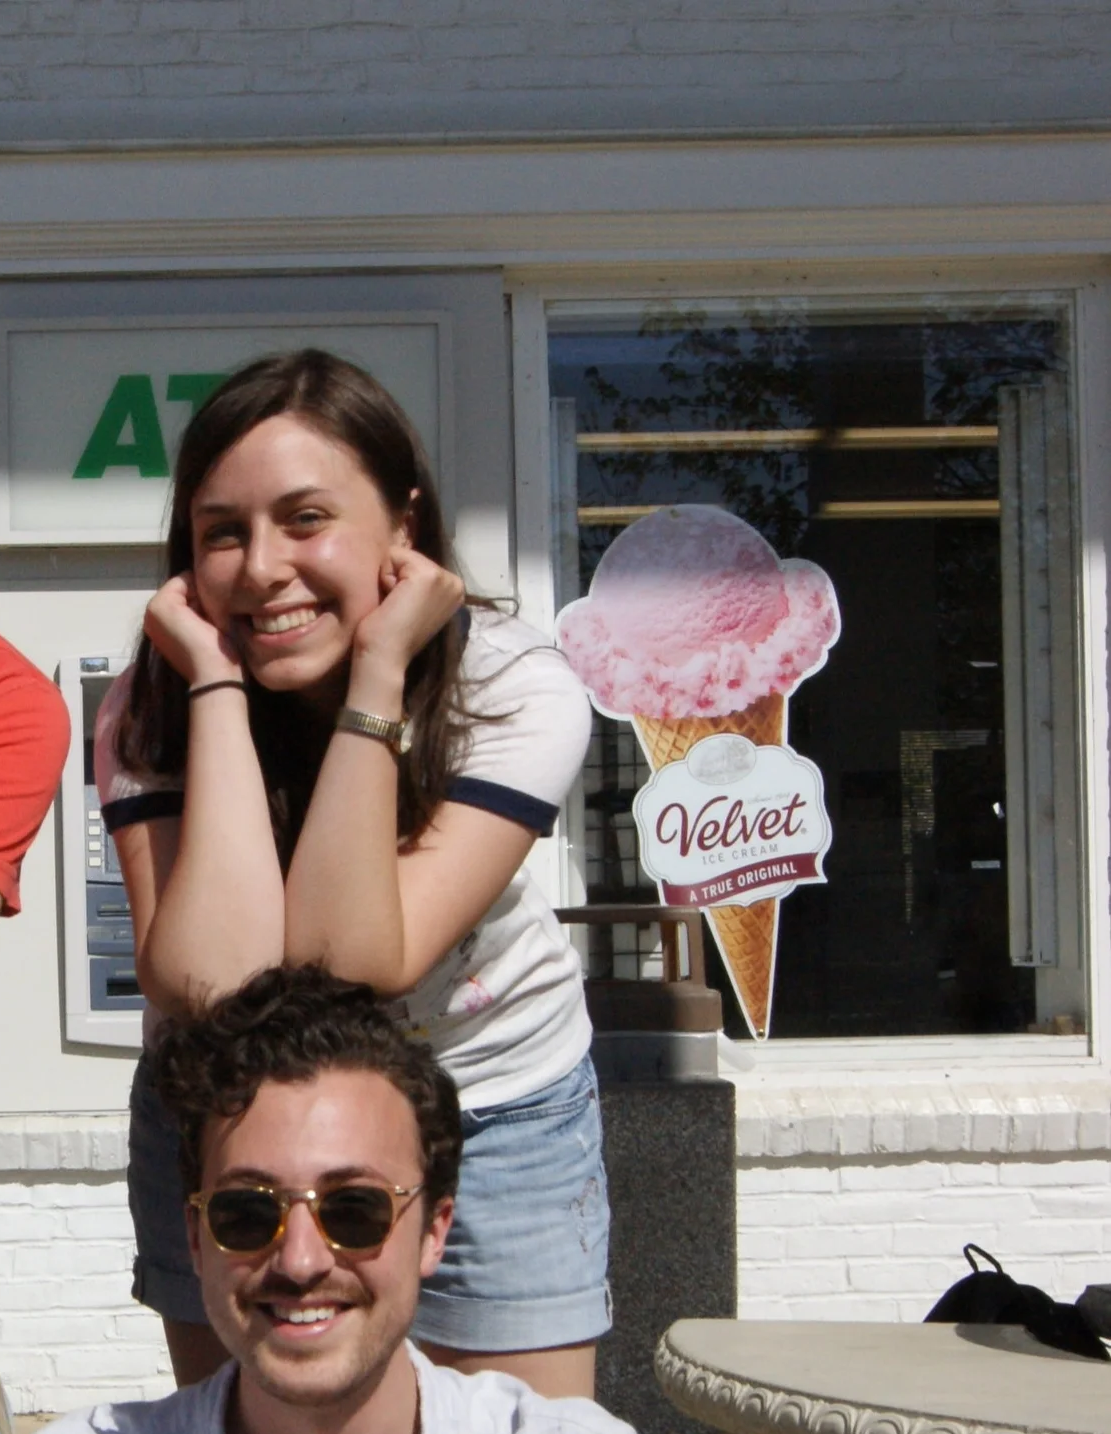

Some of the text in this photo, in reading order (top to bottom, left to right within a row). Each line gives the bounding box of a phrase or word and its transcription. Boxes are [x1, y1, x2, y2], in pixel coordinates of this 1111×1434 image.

[656, 793, 807, 857] Velvet
[702, 844, 779, 866] ICE CREAM
[690, 861, 798, 902] A TRUE ORIGINAL
